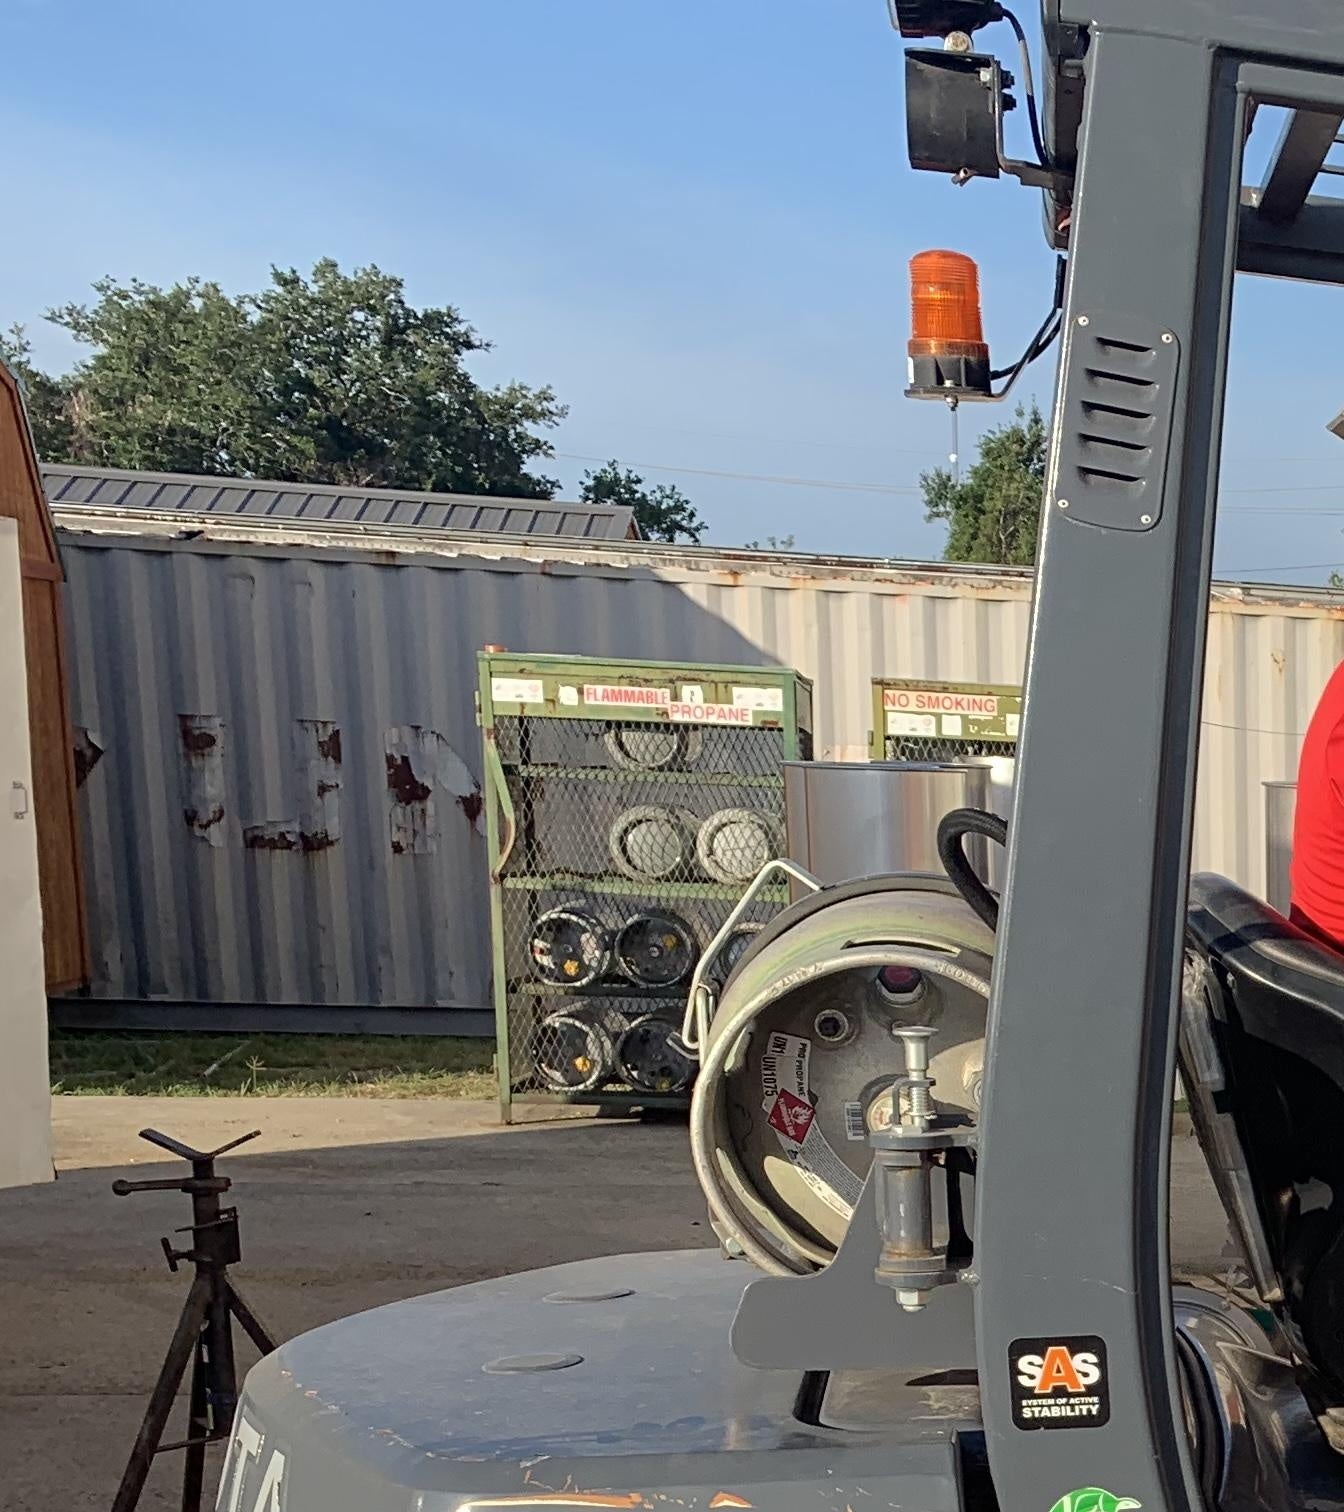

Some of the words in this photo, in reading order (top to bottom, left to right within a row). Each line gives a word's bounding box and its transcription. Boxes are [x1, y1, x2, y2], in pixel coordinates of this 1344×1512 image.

[585, 686, 669, 706] FLAMMABLE
[884, 693, 910, 708] NO
[915, 694, 997, 713] SMOKING
[669, 703, 750, 722] PROPANE
[762, 1056, 779, 1097] UN1075
[1017, 1346, 1100, 1394] SAS
[1021, 1398, 1055, 1407] SYSTEM
[1056, 1397, 1067, 1405] OF
[1069, 1396, 1100, 1405] ACTIVE
[1022, 1404, 1100, 1418] STABILITY
